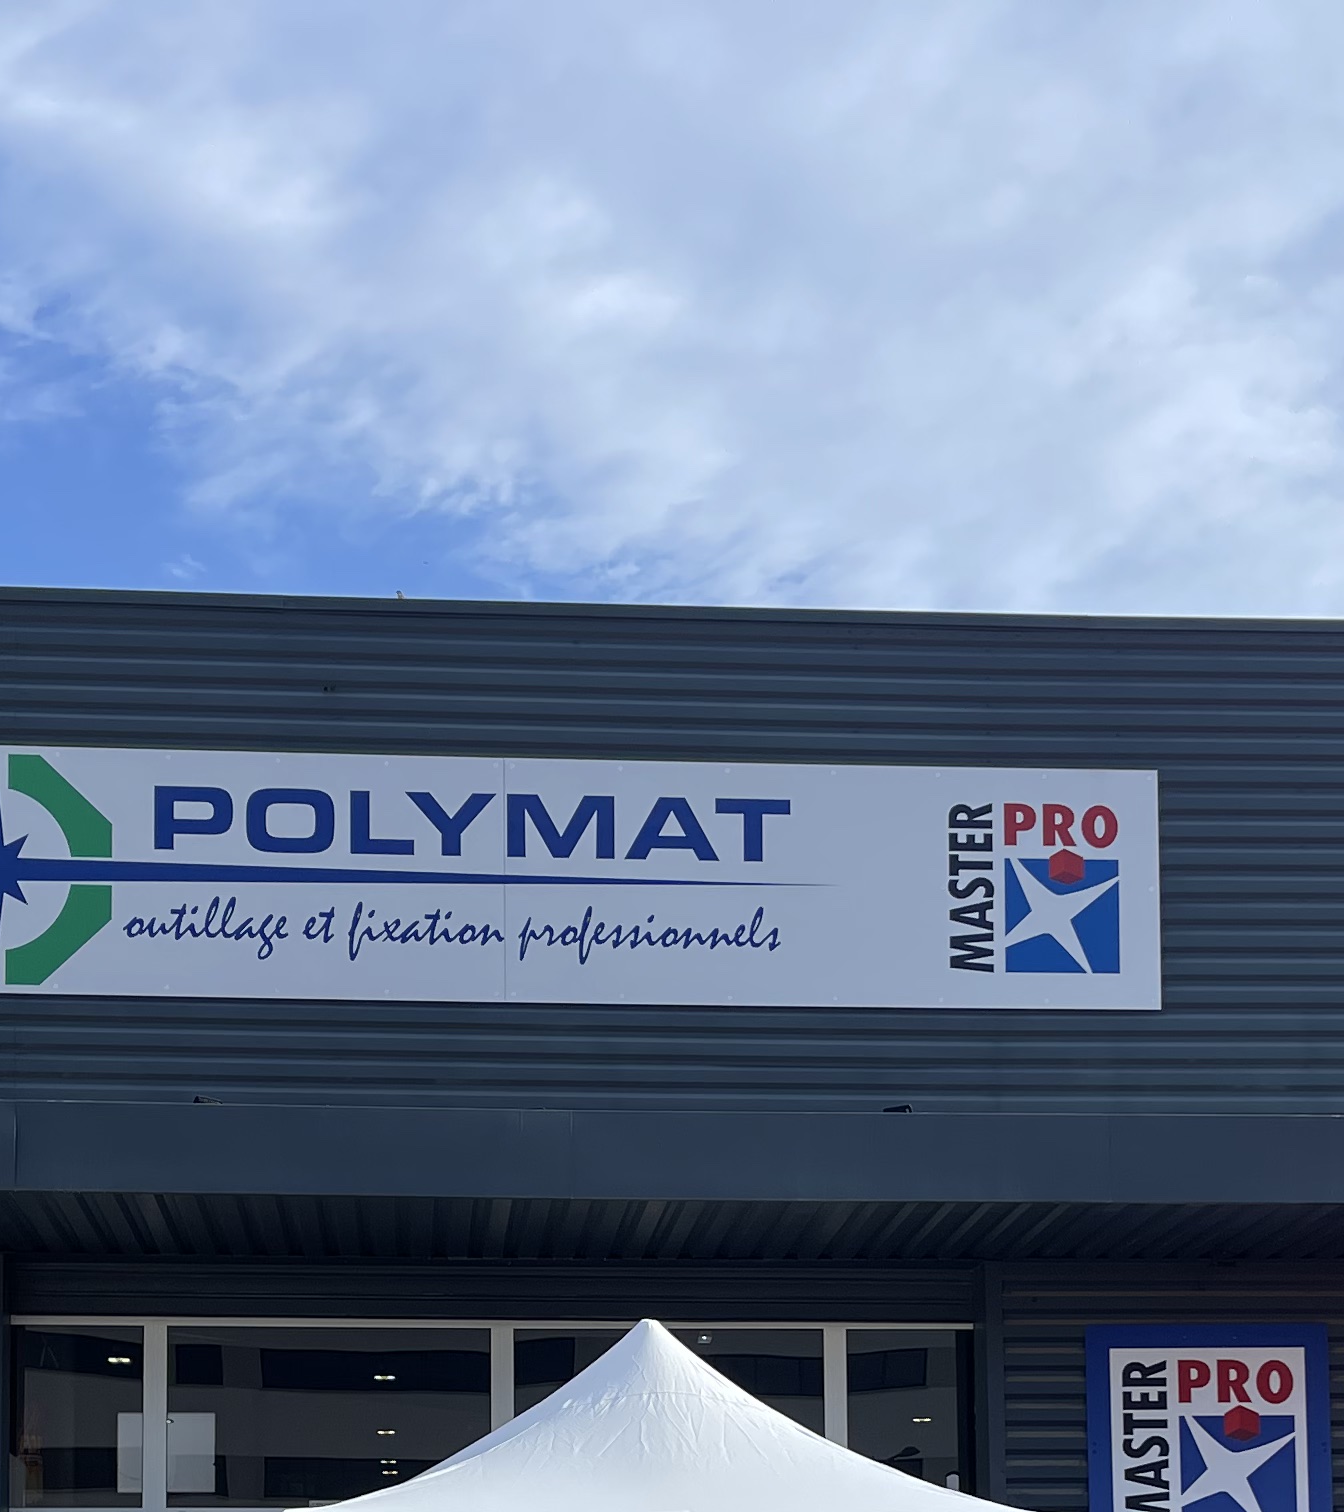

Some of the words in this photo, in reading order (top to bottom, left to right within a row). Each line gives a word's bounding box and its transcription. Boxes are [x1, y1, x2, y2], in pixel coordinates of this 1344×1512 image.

[154, 785, 791, 863] POLYMAT
[1002, 802, 1118, 849] PRO
[948, 802, 994, 974] MASTER
[123, 896, 289, 960] outillage
[302, 900, 336, 944] et
[347, 901, 504, 961] fixation
[517, 905, 782, 965] professionnels
[1177, 1359, 1294, 1404] PRO
